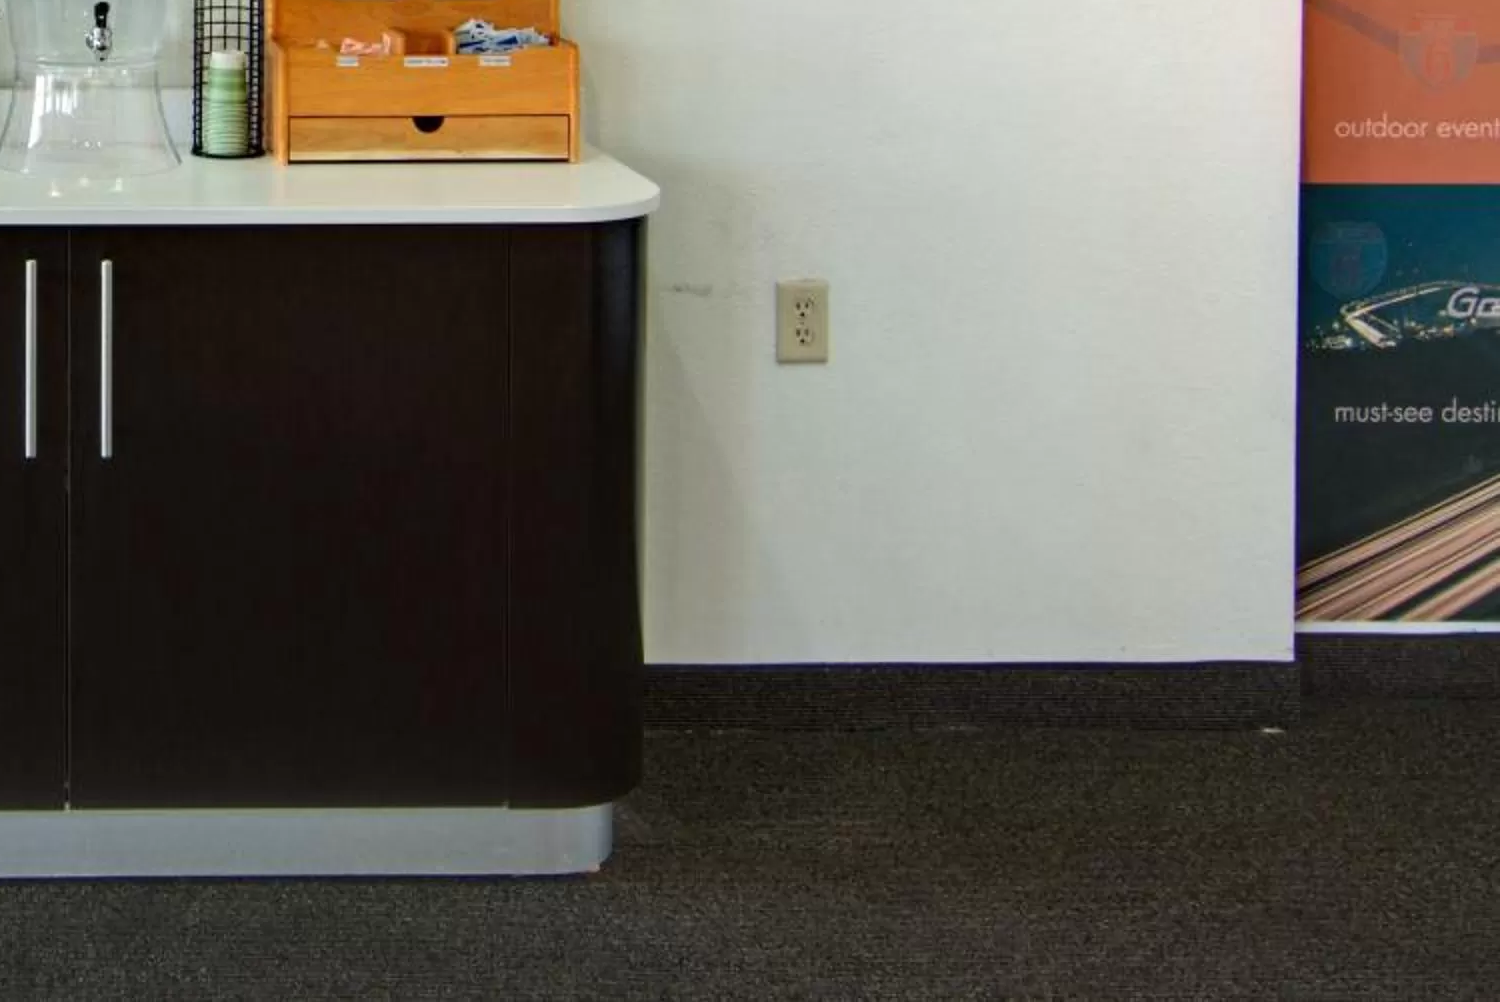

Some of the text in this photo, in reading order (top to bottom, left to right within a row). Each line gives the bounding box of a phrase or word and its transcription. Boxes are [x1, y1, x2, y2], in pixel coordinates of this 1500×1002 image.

[1334, 110, 1429, 138] outdoor
[1334, 396, 1500, 423] must-see desti
